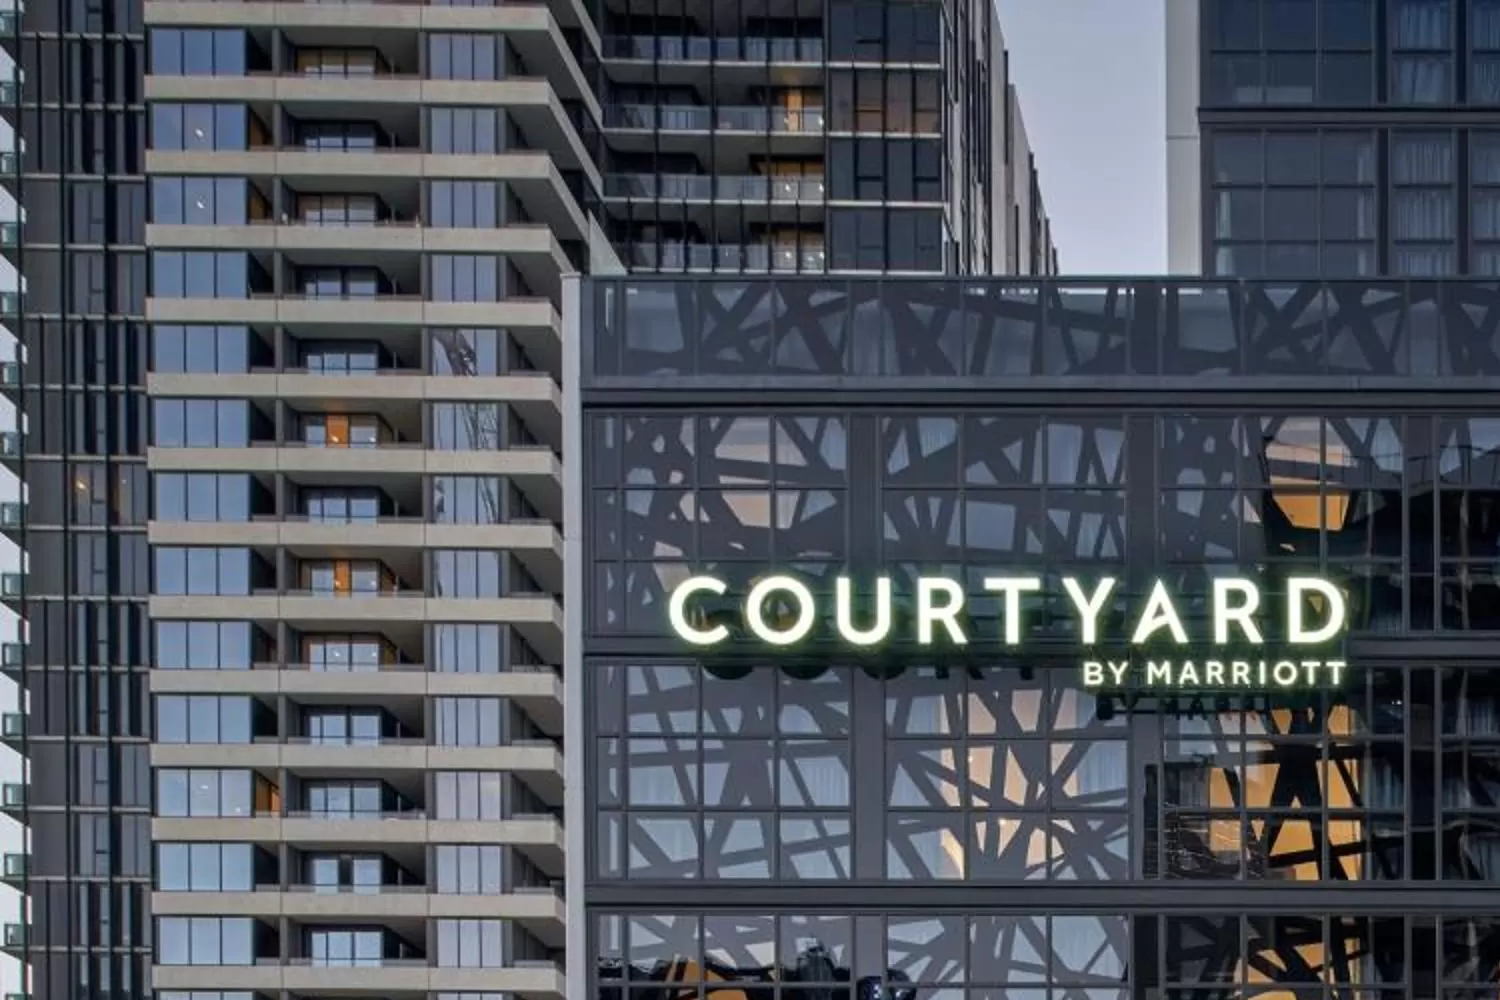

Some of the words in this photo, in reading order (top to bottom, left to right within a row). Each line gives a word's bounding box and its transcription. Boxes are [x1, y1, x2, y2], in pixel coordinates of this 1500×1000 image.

[668, 575, 1346, 645] COURTYARD
[1083, 660, 1129, 686] BY
[1147, 660, 1347, 686] MARRIOTT
